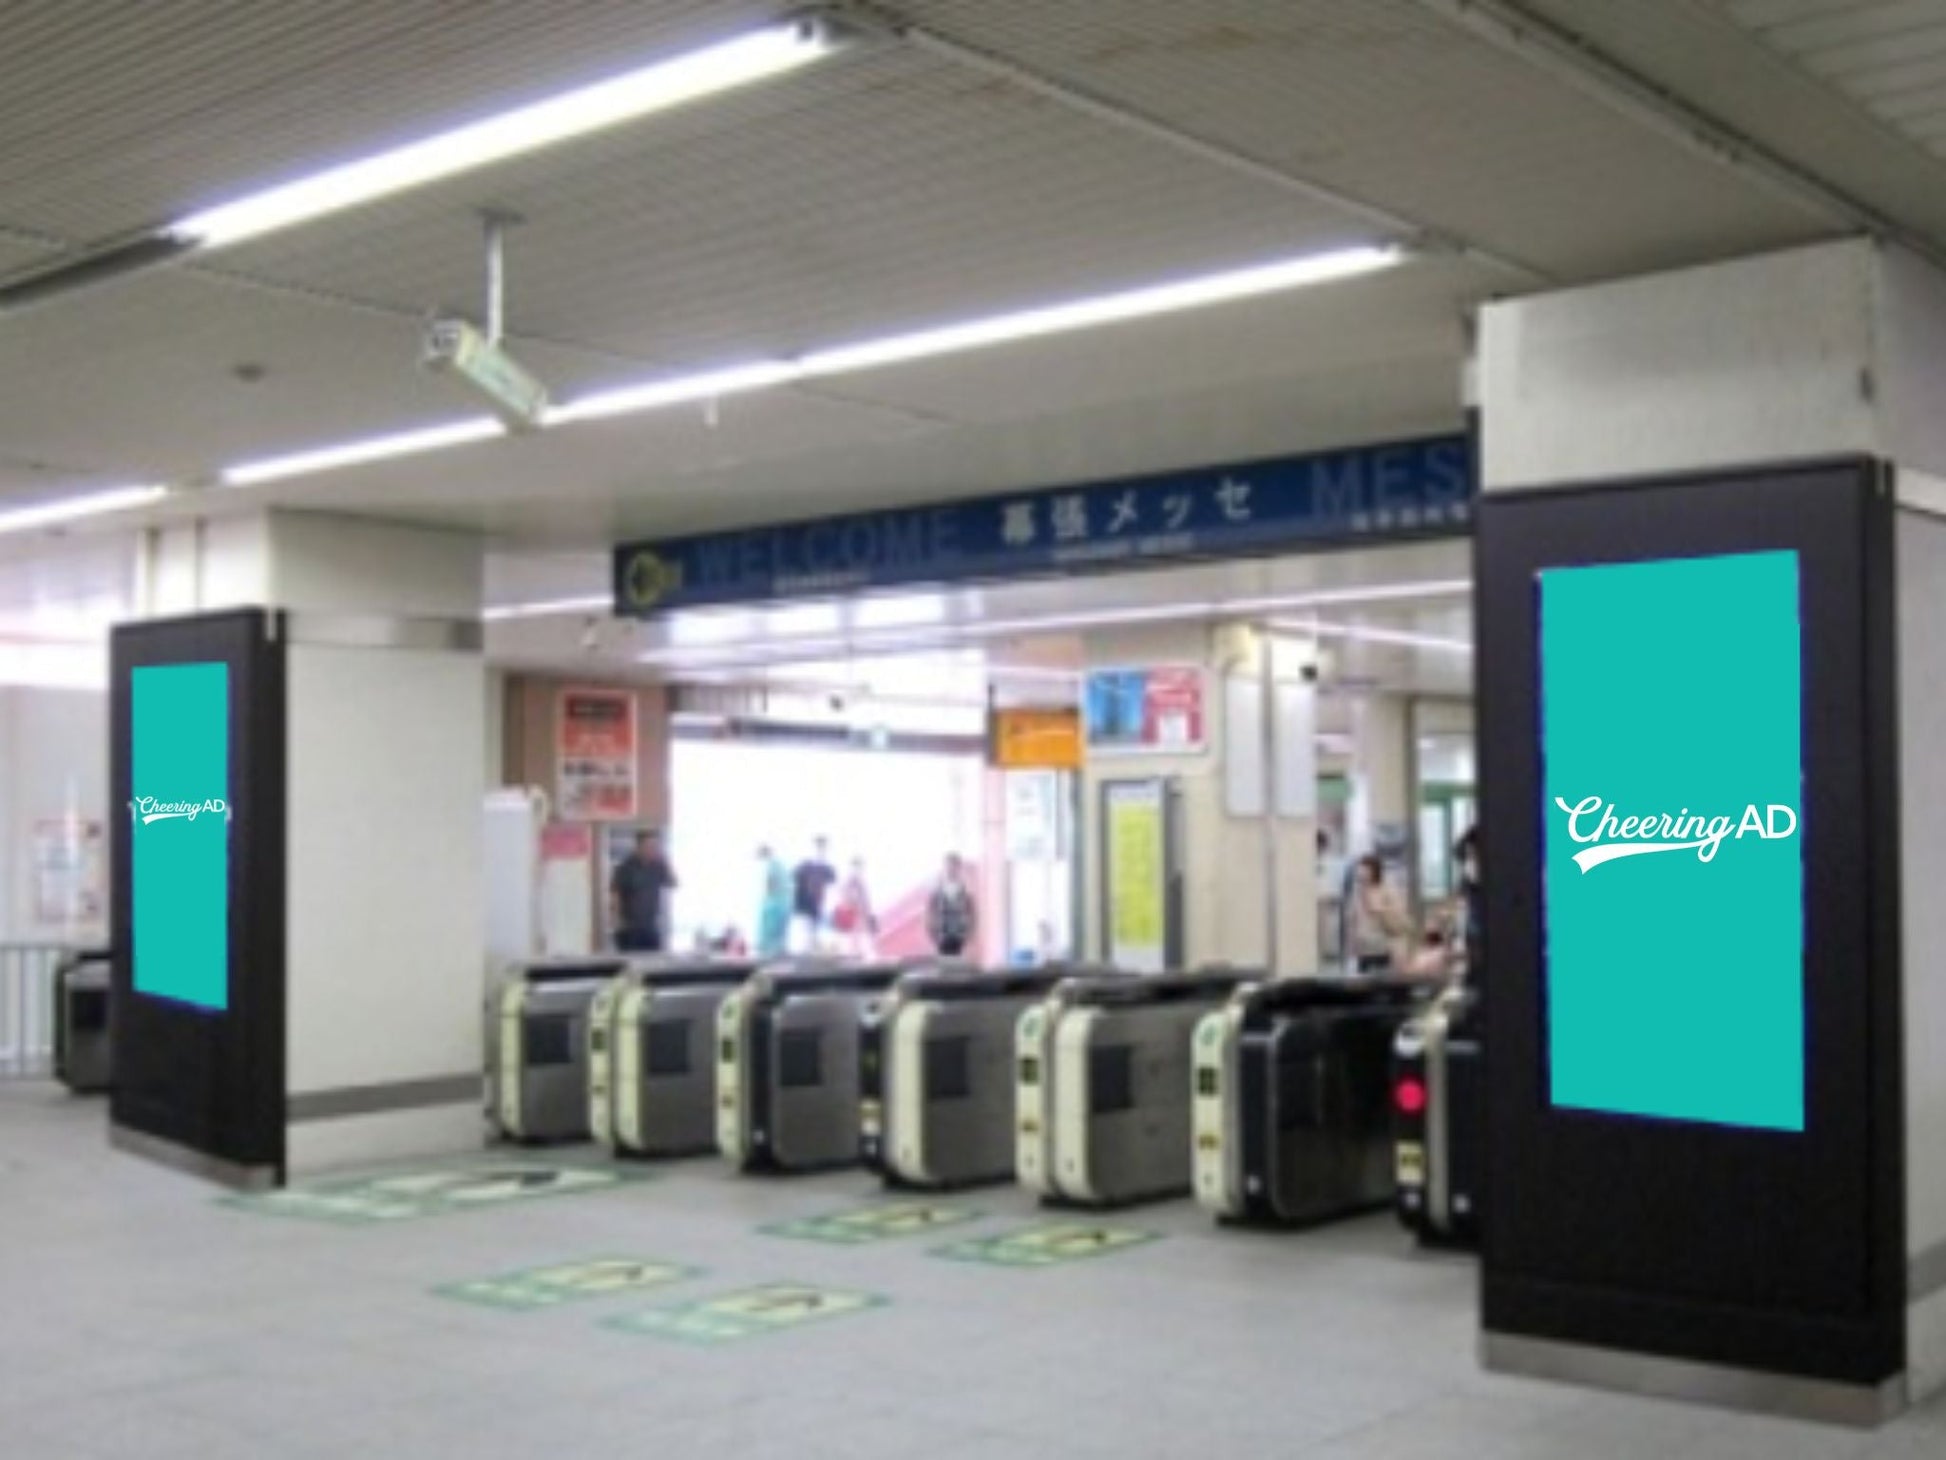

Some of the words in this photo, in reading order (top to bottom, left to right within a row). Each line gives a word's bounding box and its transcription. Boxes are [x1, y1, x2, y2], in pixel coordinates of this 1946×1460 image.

[1311, 443, 1465, 514] MES
[697, 509, 958, 586] WELCOME
[1555, 796, 1736, 863] Cheering
[1735, 804, 1797, 839] AD
